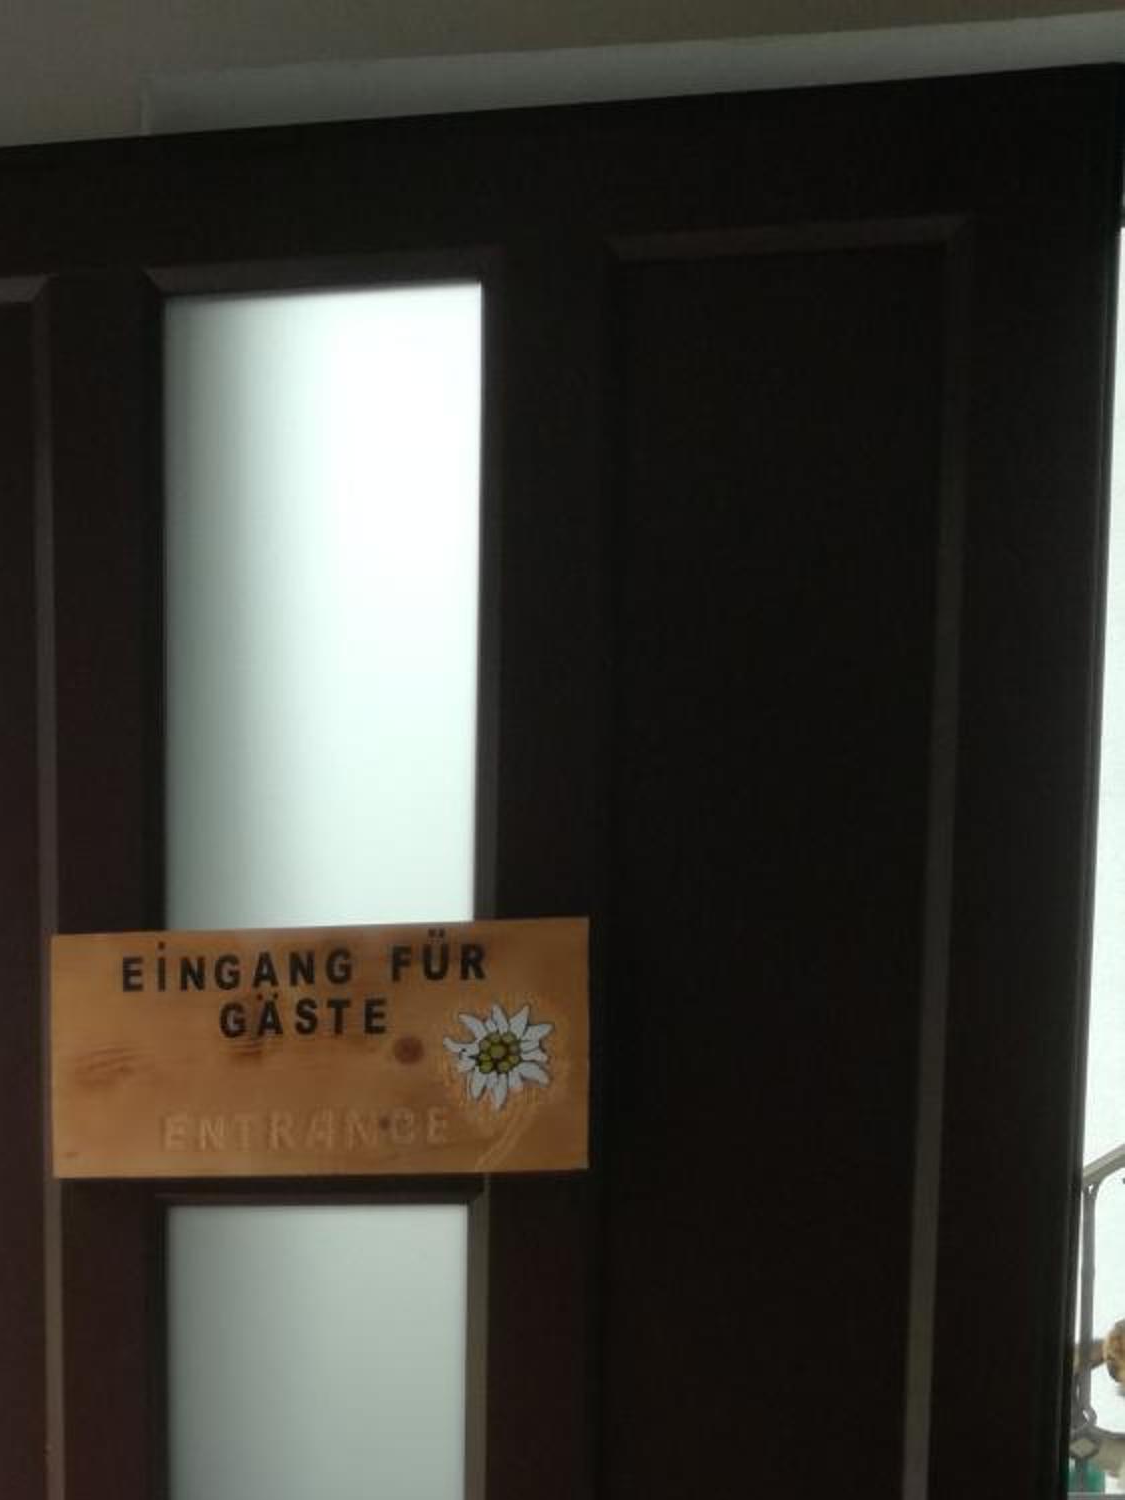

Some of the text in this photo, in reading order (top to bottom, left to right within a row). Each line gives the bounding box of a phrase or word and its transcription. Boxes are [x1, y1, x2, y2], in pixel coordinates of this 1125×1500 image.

[390, 929, 488, 982] FÜR
[219, 993, 388, 1038] GÄSTE
[163, 1106, 451, 1153] ENTRANCE
